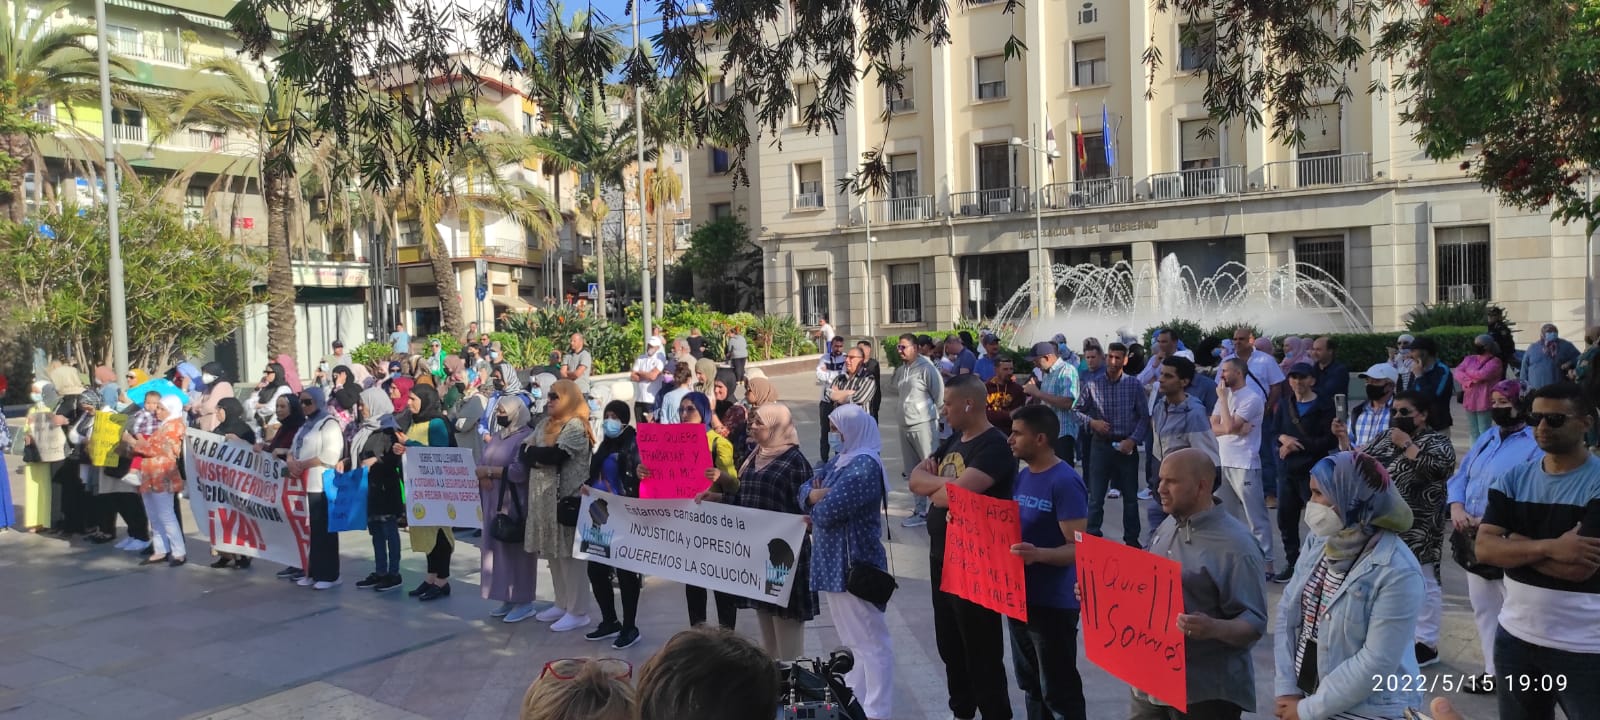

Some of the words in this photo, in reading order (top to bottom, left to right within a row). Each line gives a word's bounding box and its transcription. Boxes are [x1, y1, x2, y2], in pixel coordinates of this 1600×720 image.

[1082, 223, 1101, 235] DEL
[1109, 219, 1158, 233] GOBIERNO
[663, 431, 698, 444] QUIERO
[208, 507, 266, 551] ¡YA!
[624, 503, 672, 520] Estamos
[673, 507, 718, 527] cansados
[720, 512, 734, 529] de
[736, 515, 746, 532] la
[630, 523, 684, 545] INJUSTICIA
[685, 535, 692, 549] y
[693, 532, 751, 561] OPRESIÓN
[614, 545, 682, 571] ¡QUEREMOS
[684, 558, 698, 575] LA
